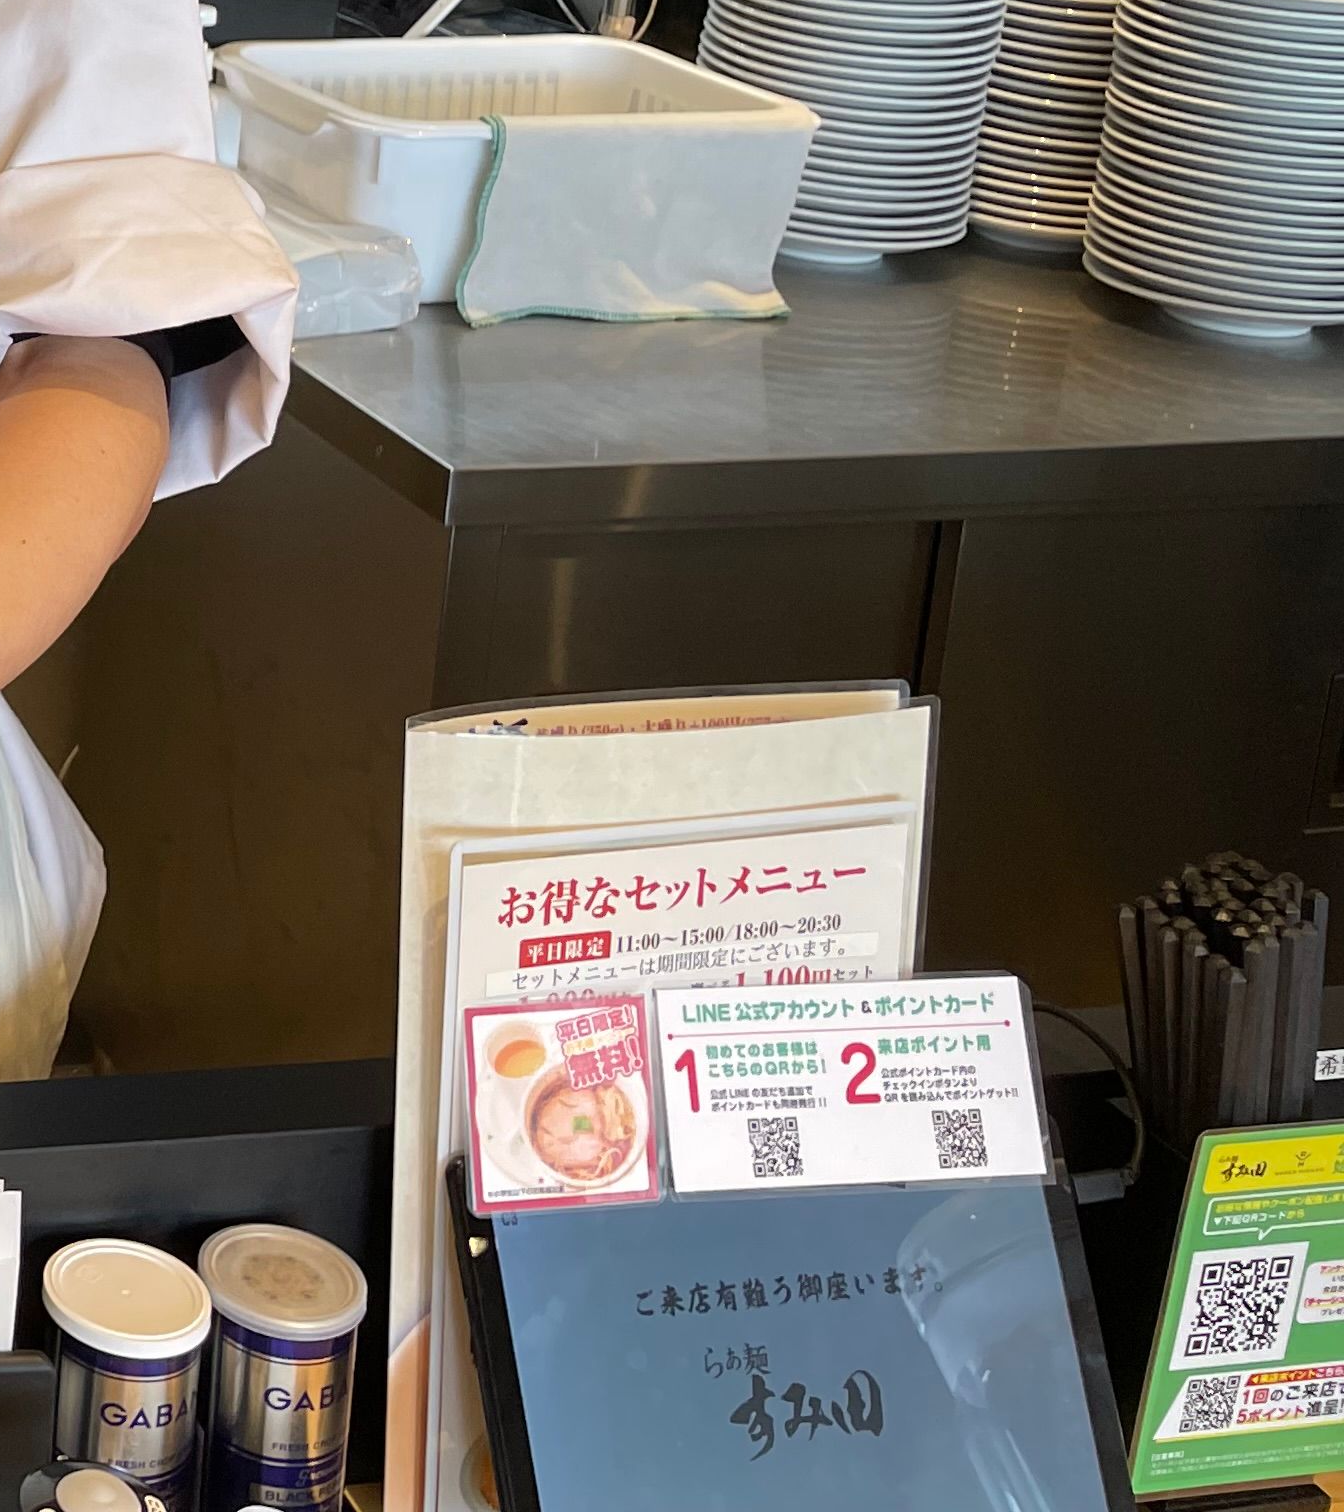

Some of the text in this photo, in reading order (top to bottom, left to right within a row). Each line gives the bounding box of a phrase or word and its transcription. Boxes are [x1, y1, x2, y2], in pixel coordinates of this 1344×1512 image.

[498, 866, 867, 928] お得なセットメニュー
[513, 938, 847, 991] セットメニューは期間限定にございます。
[527, 937, 605, 964] 平日限定
[683, 1004, 730, 1022] LINE
[735, 997, 855, 1021] 公式アカウント
[875, 992, 994, 1017] ポイントカード
[706, 1041, 818, 1059] 初めてのお客様は
[878, 1035, 991, 1055] 来店ポイント用
[675, 1049, 699, 1113] 1
[841, 1042, 881, 1104] 2
[636, 1263, 944, 1317] ご来店有難う御座います。
[705, 1343, 771, 1379] らぁ麺
[100, 1392, 197, 1429] GABA
[730, 1369, 884, 1461] すみ田
